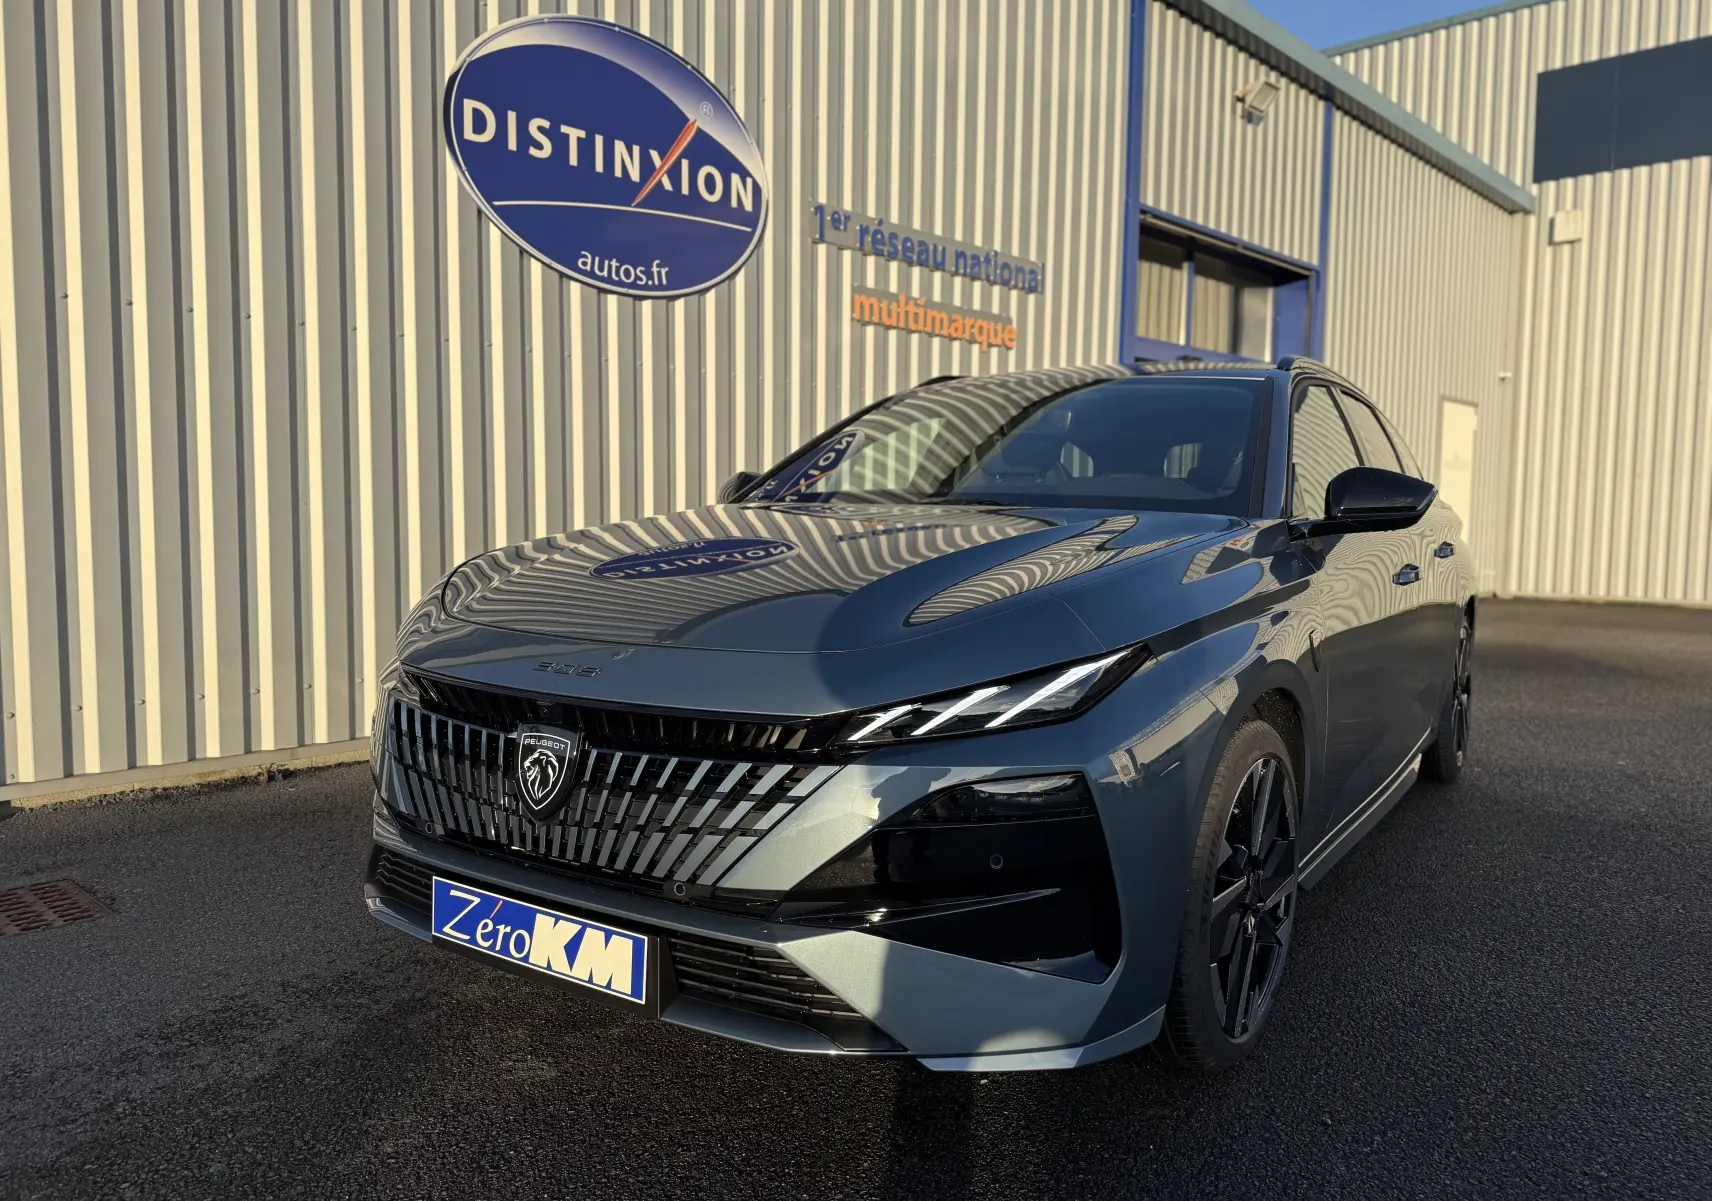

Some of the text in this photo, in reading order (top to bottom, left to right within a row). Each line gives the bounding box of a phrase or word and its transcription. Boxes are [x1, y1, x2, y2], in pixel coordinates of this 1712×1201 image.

[463, 98, 753, 212] DISTINXION
[577, 250, 669, 286] autos.fr
[813, 204, 1045, 294] 1er réseau national
[853, 293, 1017, 353] multimarque
[524, 738, 566, 750] PEUGEOT
